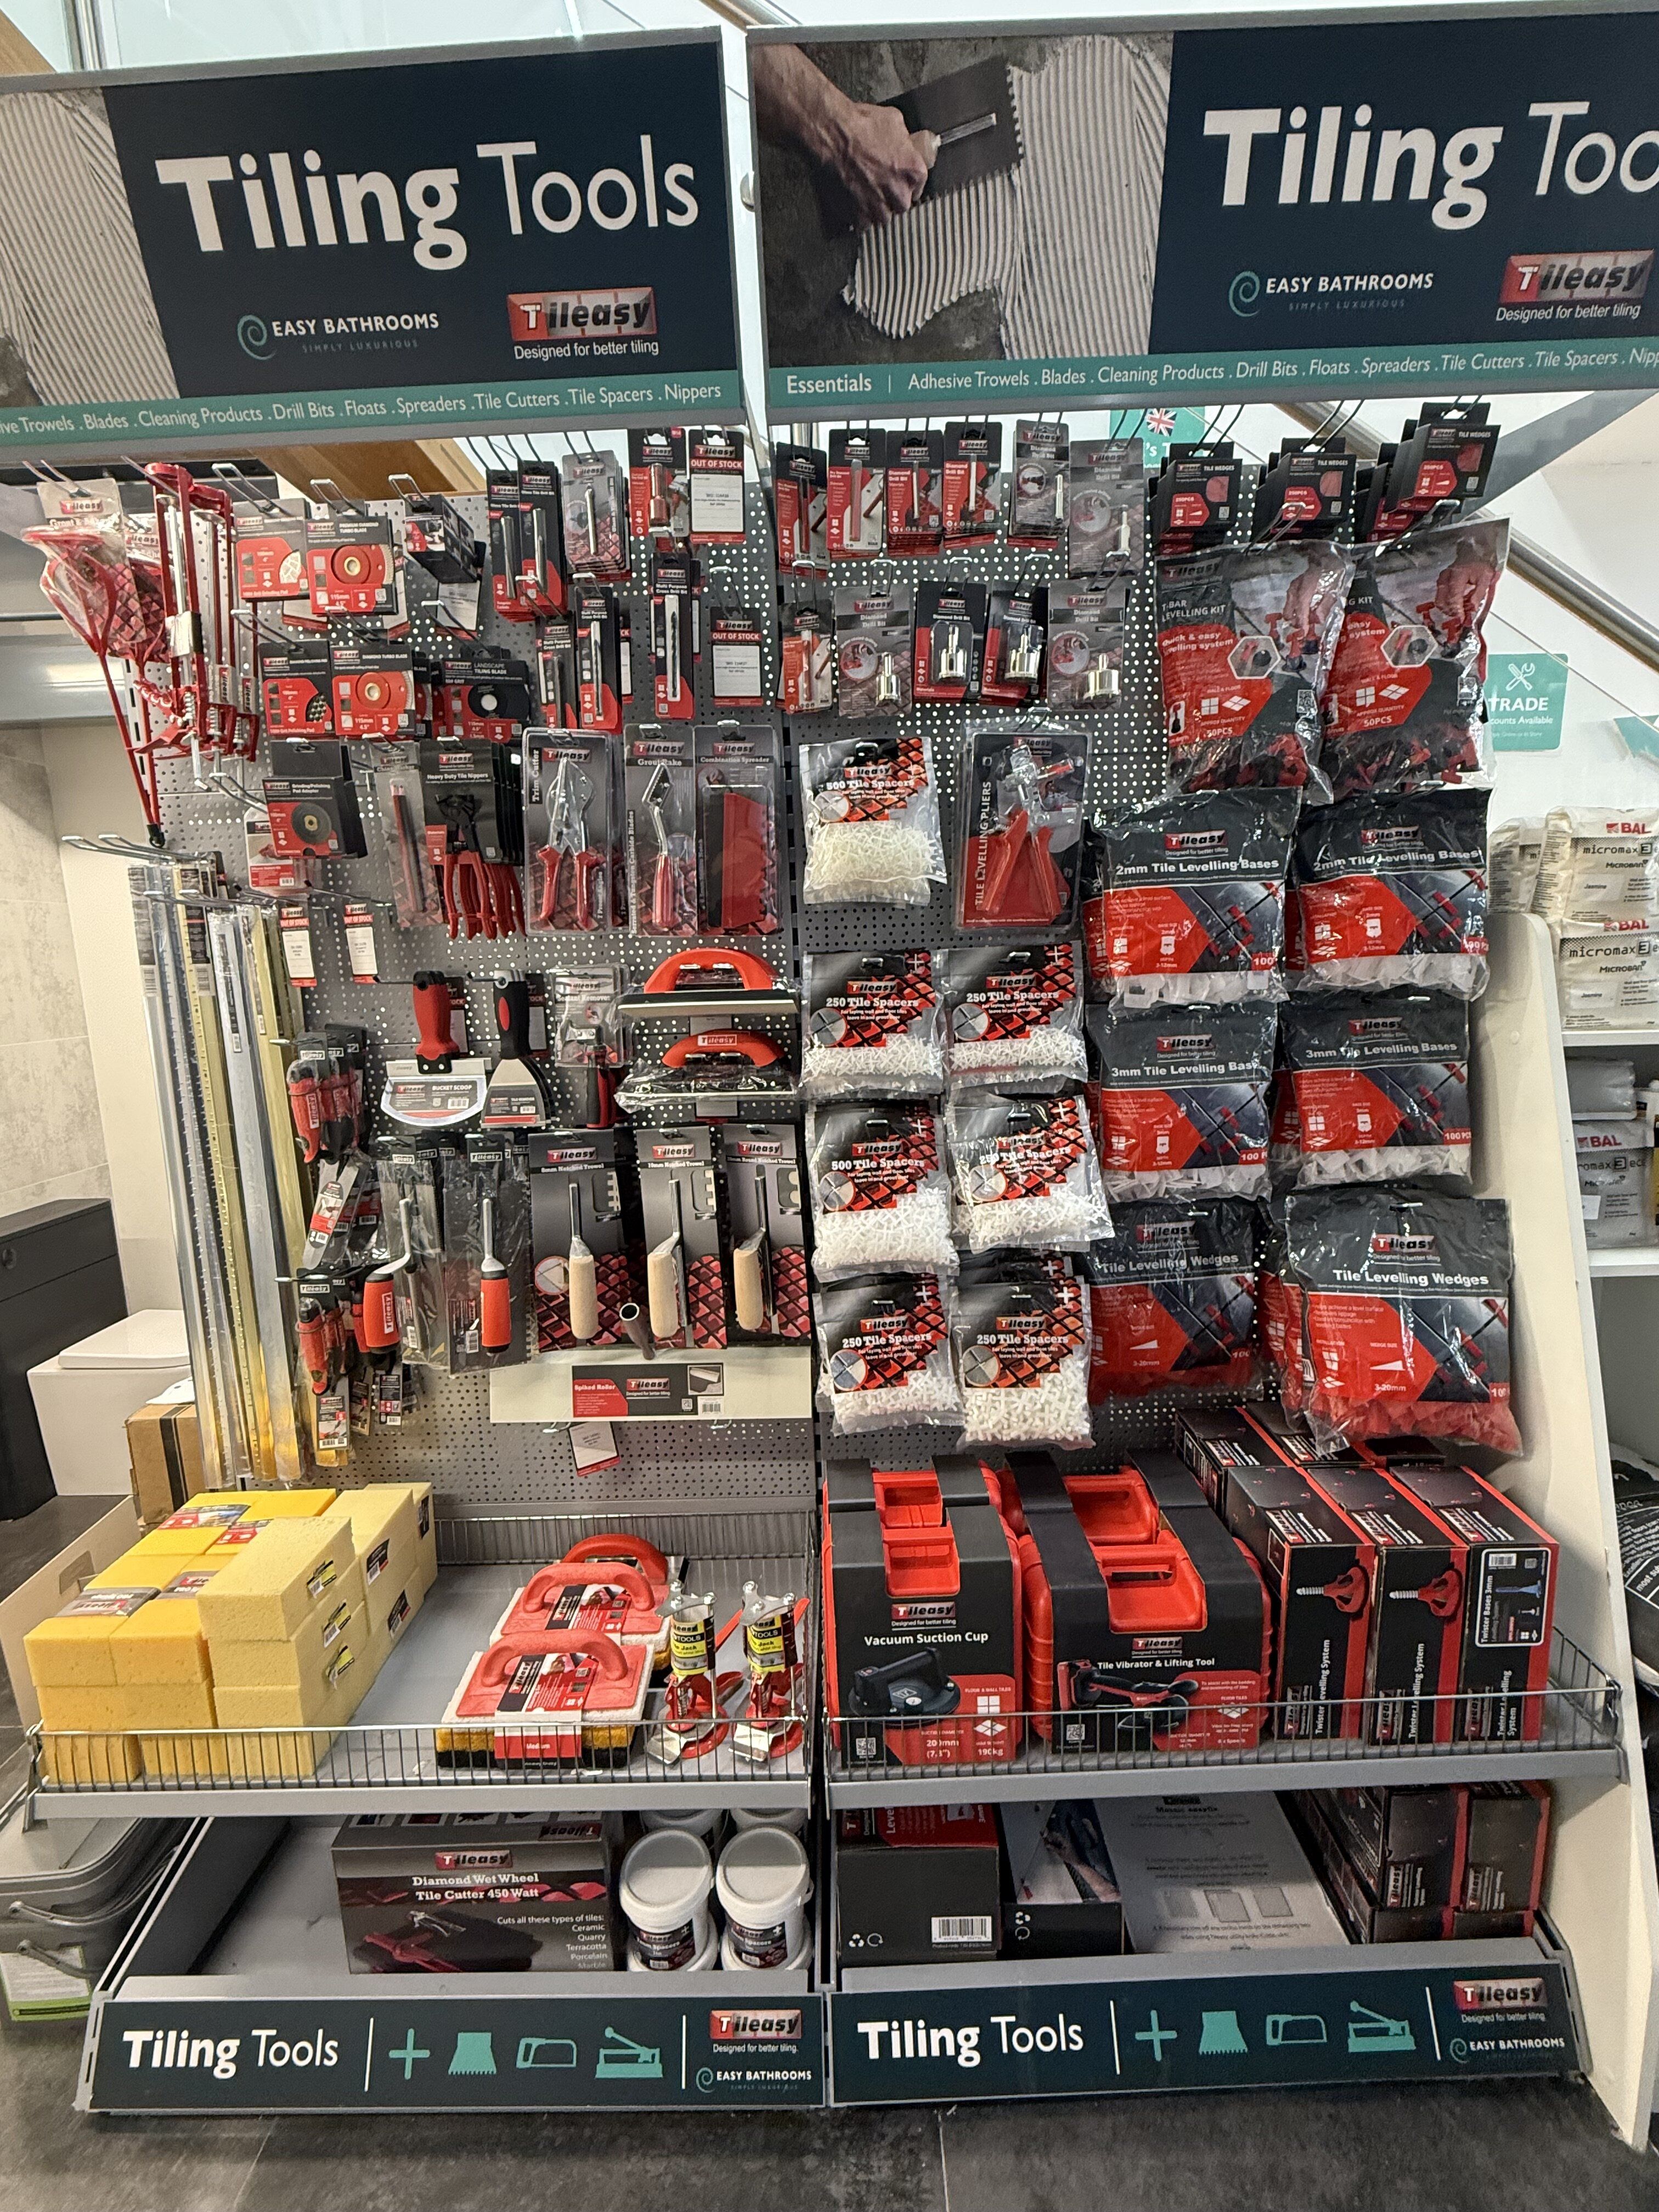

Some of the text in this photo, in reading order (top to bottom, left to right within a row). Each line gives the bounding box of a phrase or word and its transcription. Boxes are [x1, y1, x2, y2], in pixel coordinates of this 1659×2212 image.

[1204, 100, 1659, 230] Tiling Too
[155, 134, 699, 270] Tiling Tools
[1518, 261, 1644, 291] Tileasy
[1266, 273, 1433, 294] EASY BATHROOMS
[1289, 300, 1405, 311] SIMPLY LUXURIOUS
[520, 301, 650, 329] Tileasy
[1496, 303, 1641, 324] Designed for better tiling
[272, 313, 439, 336] EASY BATHROOMS
[302, 339, 418, 352] SIMPLY LUXURIOUS
[515, 340, 658, 362] Designed for better tiling
[787, 373, 872, 394] Essentials
[909, 374, 972, 390] Adhesive
[975, 371, 1029, 388] Trowels
[1041, 369, 1086, 385] Blades
[1098, 365, 1158, 387] Cleaning
[1163, 363, 1224, 381] Products
[1237, 362, 1268, 377] Drill
[1272, 360, 1297, 376] Bits
[1310, 359, 1350, 375] Floats
[1362, 357, 1430, 377] Spreaders
[1441, 355, 1468, 371] Tile
[1471, 353, 1524, 370] Cutters
[1536, 352, 1561, 368] Tile
[1565, 349, 1618, 368] Spacers
[20, 416, 74, 432] Trowels
[84, 414, 128, 429] Blades
[138, 410, 199, 428] Cleaning
[201, 407, 263, 424] Products
[274, 403, 304, 419] Drill
[309, 401, 334, 417] Bits
[345, 399, 386, 415] Floats
[396, 396, 466, 417] Spreaders
[475, 394, 501, 409] Tile
[506, 391, 560, 408] Cutters
[568, 389, 595, 404] Tile
[600, 387, 652, 405] Spacers
[665, 383, 721, 403] Nippers
[1162, 605, 1226, 621] LEVELLING KIT
[713, 632, 727, 640] OUT
[1488, 698, 1548, 711] TRADE
[827, 778, 915, 790] 500 Tile Spacers
[1621, 823, 1651, 833] BAL
[975, 881, 984, 905] TILE
[981, 782, 991, 820] PLIERS
[1171, 834, 1224, 845] Tileasy
[1583, 844, 1638, 854] micromax
[1116, 860, 1279, 874] 2mm Tile Levelling Bases
[1619, 920, 1649, 930] BAL
[1570, 945, 1635, 958] micromax
[827, 998, 918, 1008] 250 Tile Spacers
[966, 991, 1058, 1002] 250 Tile Spacers
[1163, 1037, 1211, 1047] Tileasy
[1306, 1049, 1336, 1058] 3mm
[1364, 1045, 1419, 1056] Levelling
[1423, 1043, 1457, 1052] Bases
[1111, 1062, 1260, 1077] 3mm Tile Levelling Bas
[1590, 1136, 1622, 1147] BAL
[832, 1158, 924, 1170] 500 Tile Spacers
[1103, 1256, 1238, 1273] Tile Levelling Wedges
[1333, 1269, 1488, 1286] Tile Levelling Wedges
[842, 1333, 932, 1347] 250 Tile Spacers
[978, 1334, 1068, 1345] 250 Tile Spacers
[898, 1606, 953, 1616] Tileasy
[1483, 1597, 1492, 1618] Bases
[1481, 1618, 1489, 1643] Twister
[865, 1632, 988, 1646] Vacuum Suction Cup
[1164, 1659, 1194, 1668] Lifting
[1314, 1639, 1330, 1734] Twister evelling System
[443, 1850, 509, 1865] Tileasy
[412, 1874, 539, 1886] Diamond Wet Wheel
[416, 1888, 539, 1900] Tile Cutter 450 Watt
[551, 1915, 572, 1925] types
[572, 1923, 605, 1932] Ceramic
[578, 1934, 605, 1942] Quarry
[1464, 1986, 1542, 2002] Tileasy
[720, 2016, 799, 2034] Tileasy
[857, 2013, 1084, 2067] Tiling Tools
[1470, 2038, 1565, 2051] EASY BATHROOMS
[122, 2029, 338, 2080] Tiling Tools
[713, 2044, 745, 2054] Designed
[747, 2044, 757, 2052] for
[758, 2044, 778, 2052] better
[716, 2070, 811, 2081] EASY BATHROOMS
